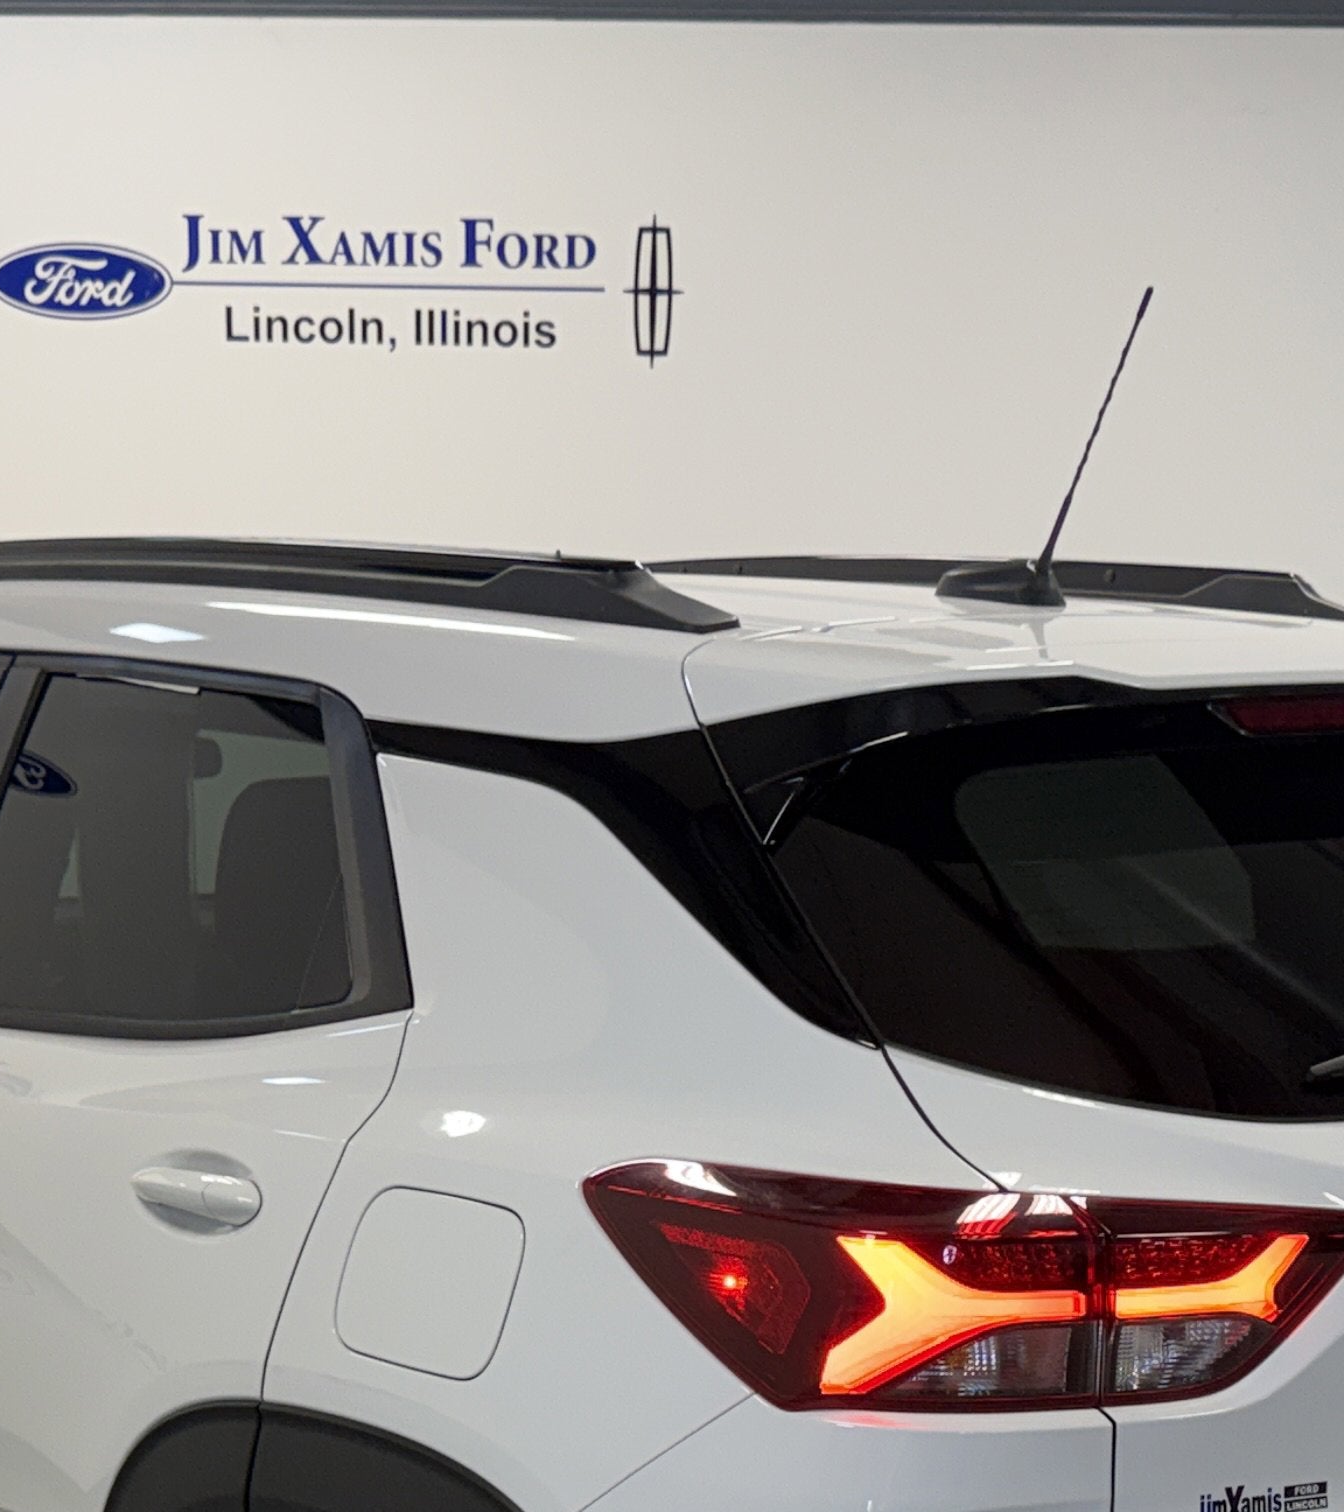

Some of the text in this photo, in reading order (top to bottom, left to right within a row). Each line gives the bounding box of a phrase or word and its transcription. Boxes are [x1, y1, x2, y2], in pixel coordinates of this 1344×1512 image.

[181, 214, 597, 274] JIM XAMIS FORD
[23, 256, 134, 309] Ford
[225, 306, 557, 353] Lincoln, Illinois
[1286, 1498, 1327, 1511] LINCOLN
[1294, 1484, 1319, 1495] FORD
